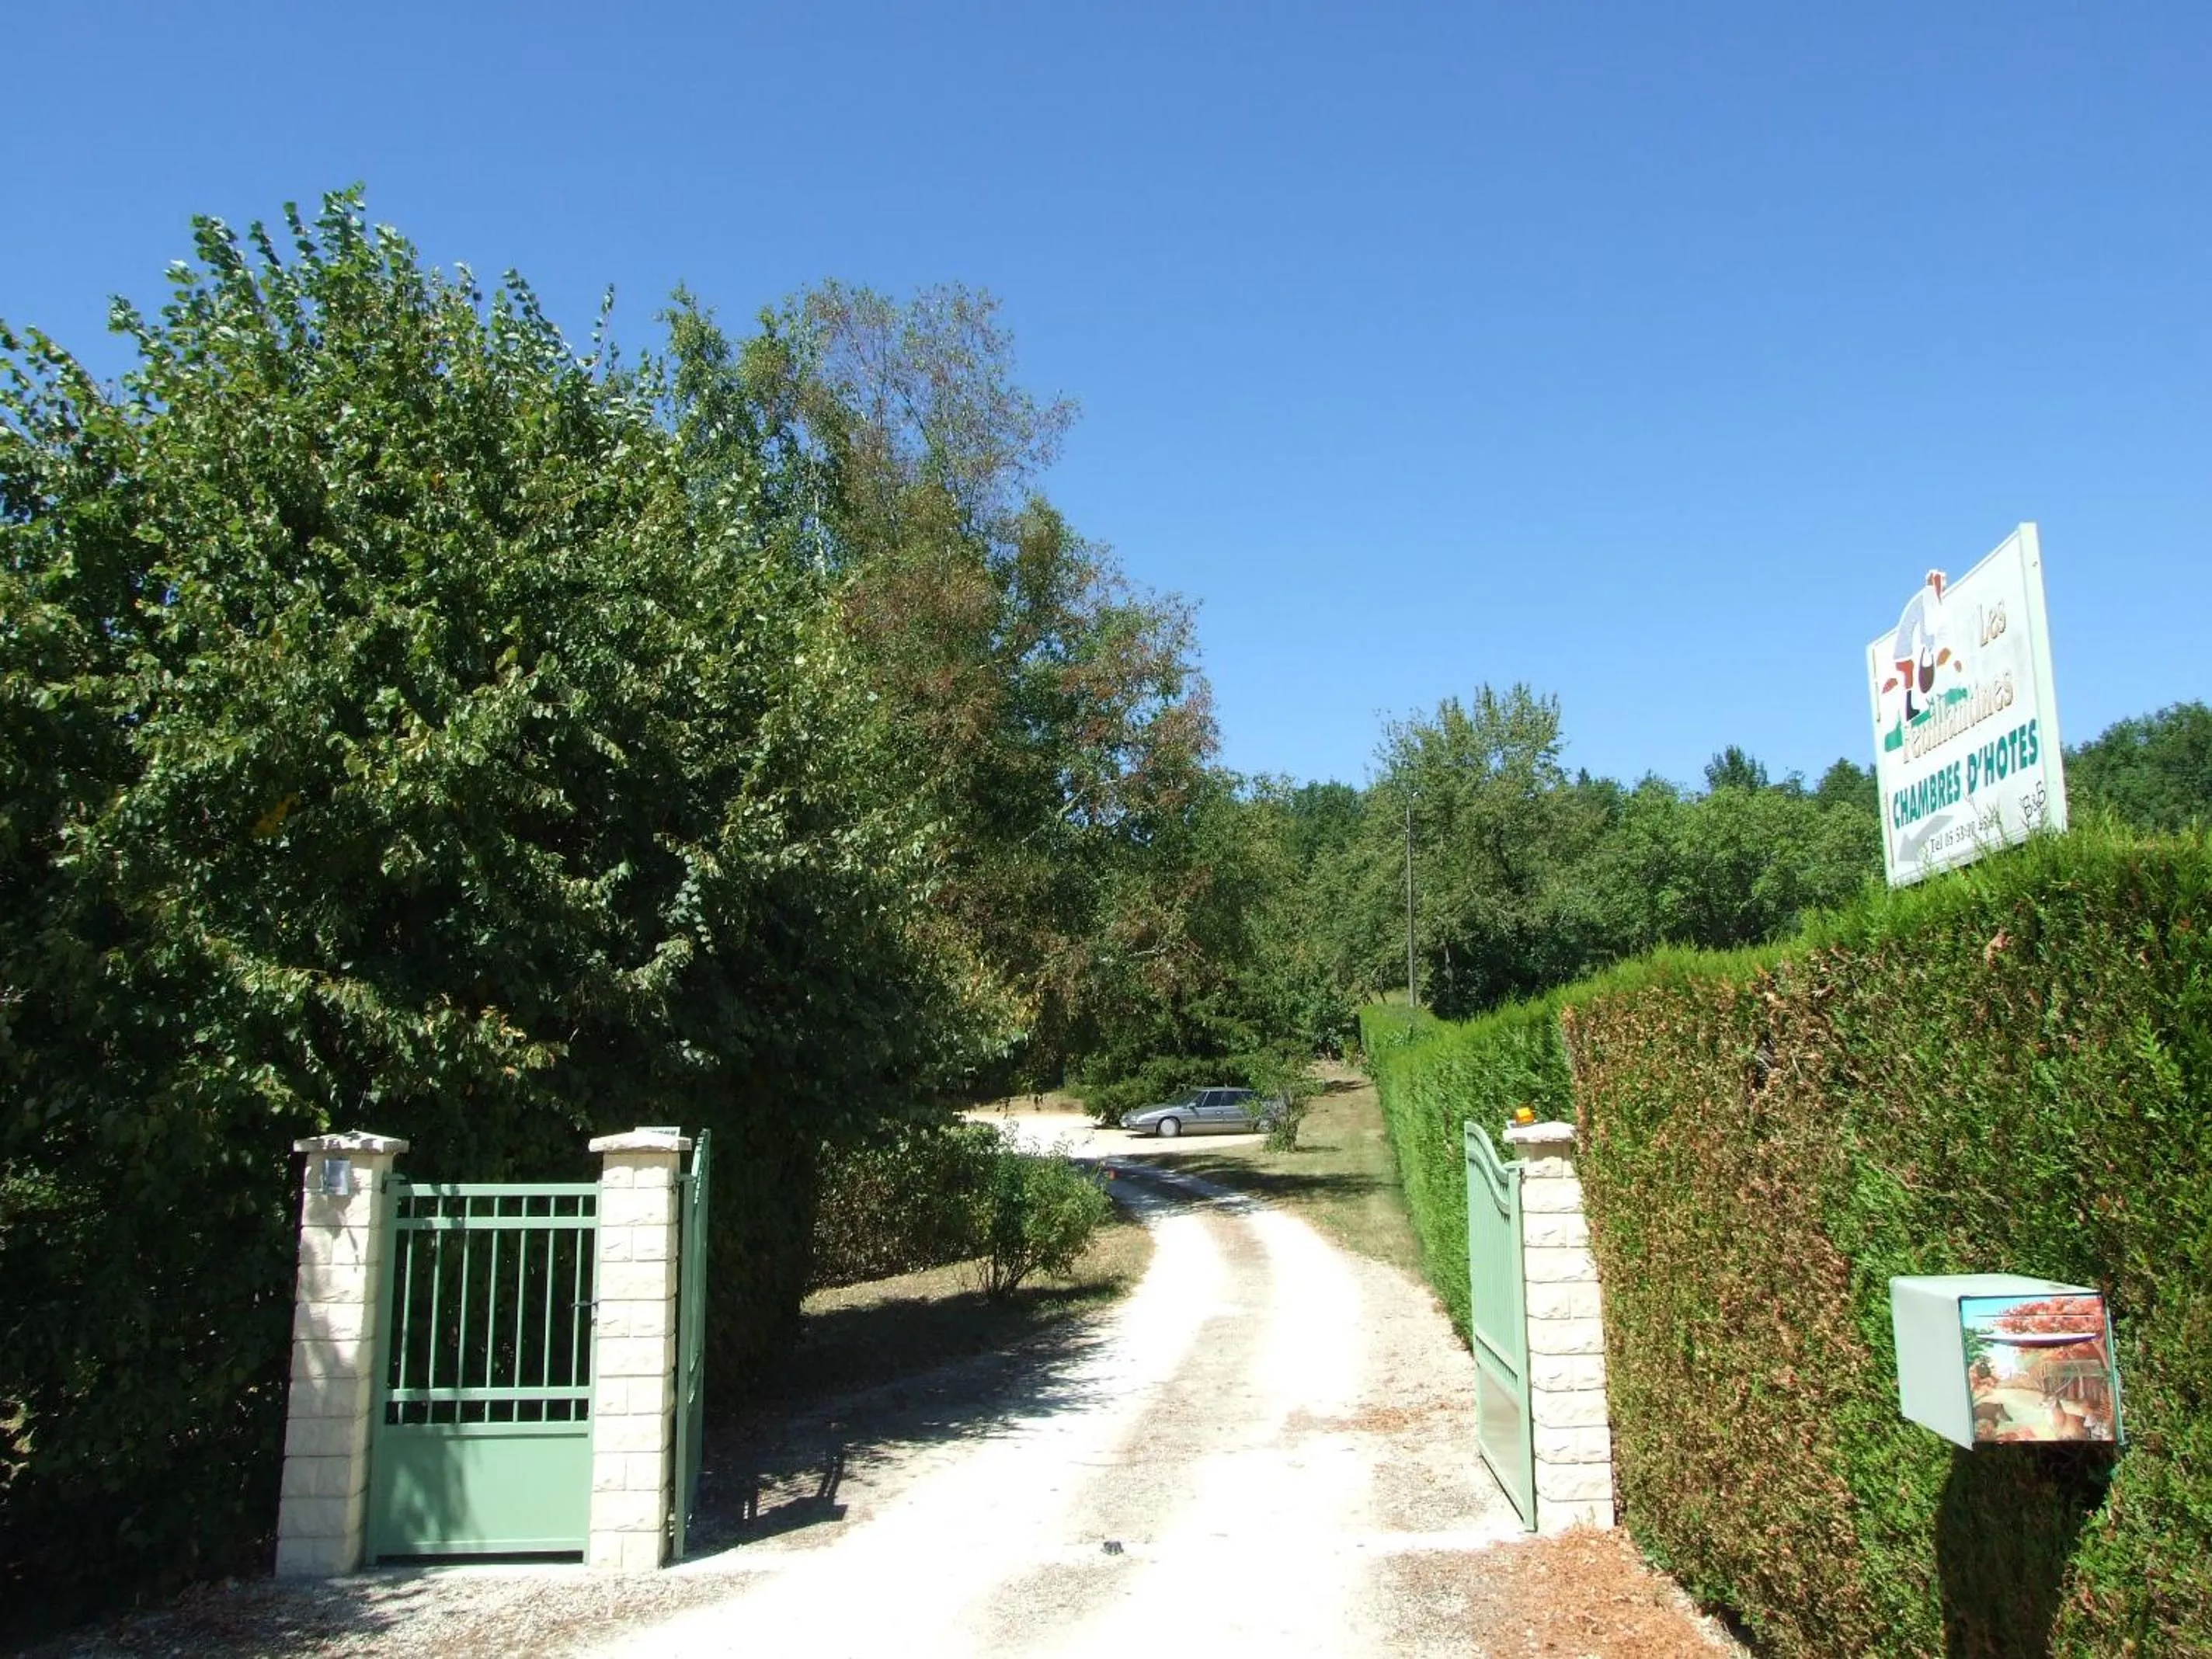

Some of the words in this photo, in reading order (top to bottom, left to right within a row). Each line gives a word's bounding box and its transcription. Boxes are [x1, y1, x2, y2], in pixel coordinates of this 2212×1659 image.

[1977, 599, 2006, 647] Les
[1893, 760, 1961, 830] CHAMBRES
[1967, 718, 2039, 795] D'HOTES
